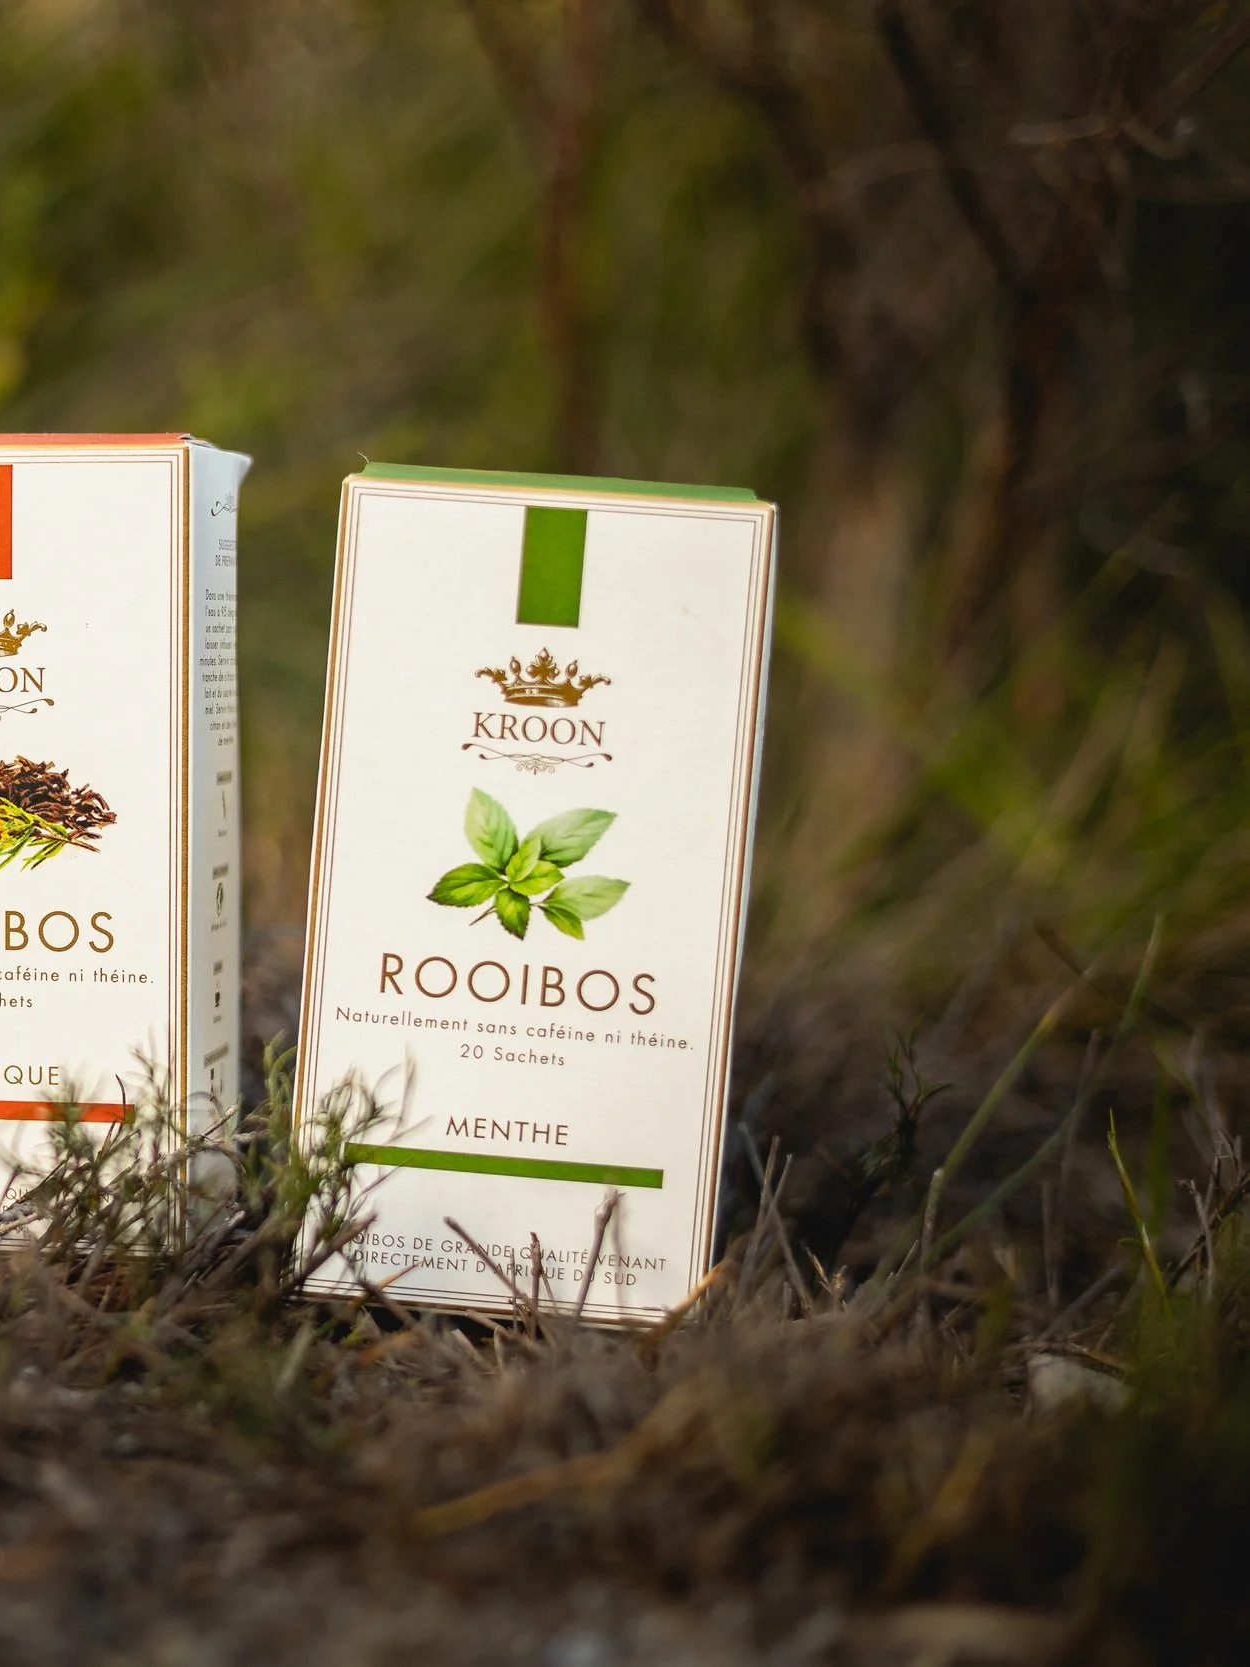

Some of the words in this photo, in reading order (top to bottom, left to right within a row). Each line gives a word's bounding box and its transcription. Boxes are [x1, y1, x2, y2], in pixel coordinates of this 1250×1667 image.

[470, 711, 607, 748] KROON
[69, 968, 84, 983] ni
[93, 967, 155, 985] théine.
[379, 952, 656, 1016] ROOIBOS
[335, 1006, 469, 1033] Naturellement
[476, 1021, 518, 1037] sans
[525, 1022, 595, 1043] caféine
[604, 1031, 622, 1045] ni
[629, 1031, 694, 1051] théine.
[459, 1043, 484, 1060] 20
[493, 1046, 565, 1067] Sachets
[445, 1116, 570, 1146] MENTHE
[352, 1232, 405, 1248] OIBOS
[413, 1237, 433, 1251] DE
[597, 1253, 667, 1271] VENANT
[353, 1249, 468, 1272] DIRECTEMENT
[603, 1271, 637, 1286] SUD
